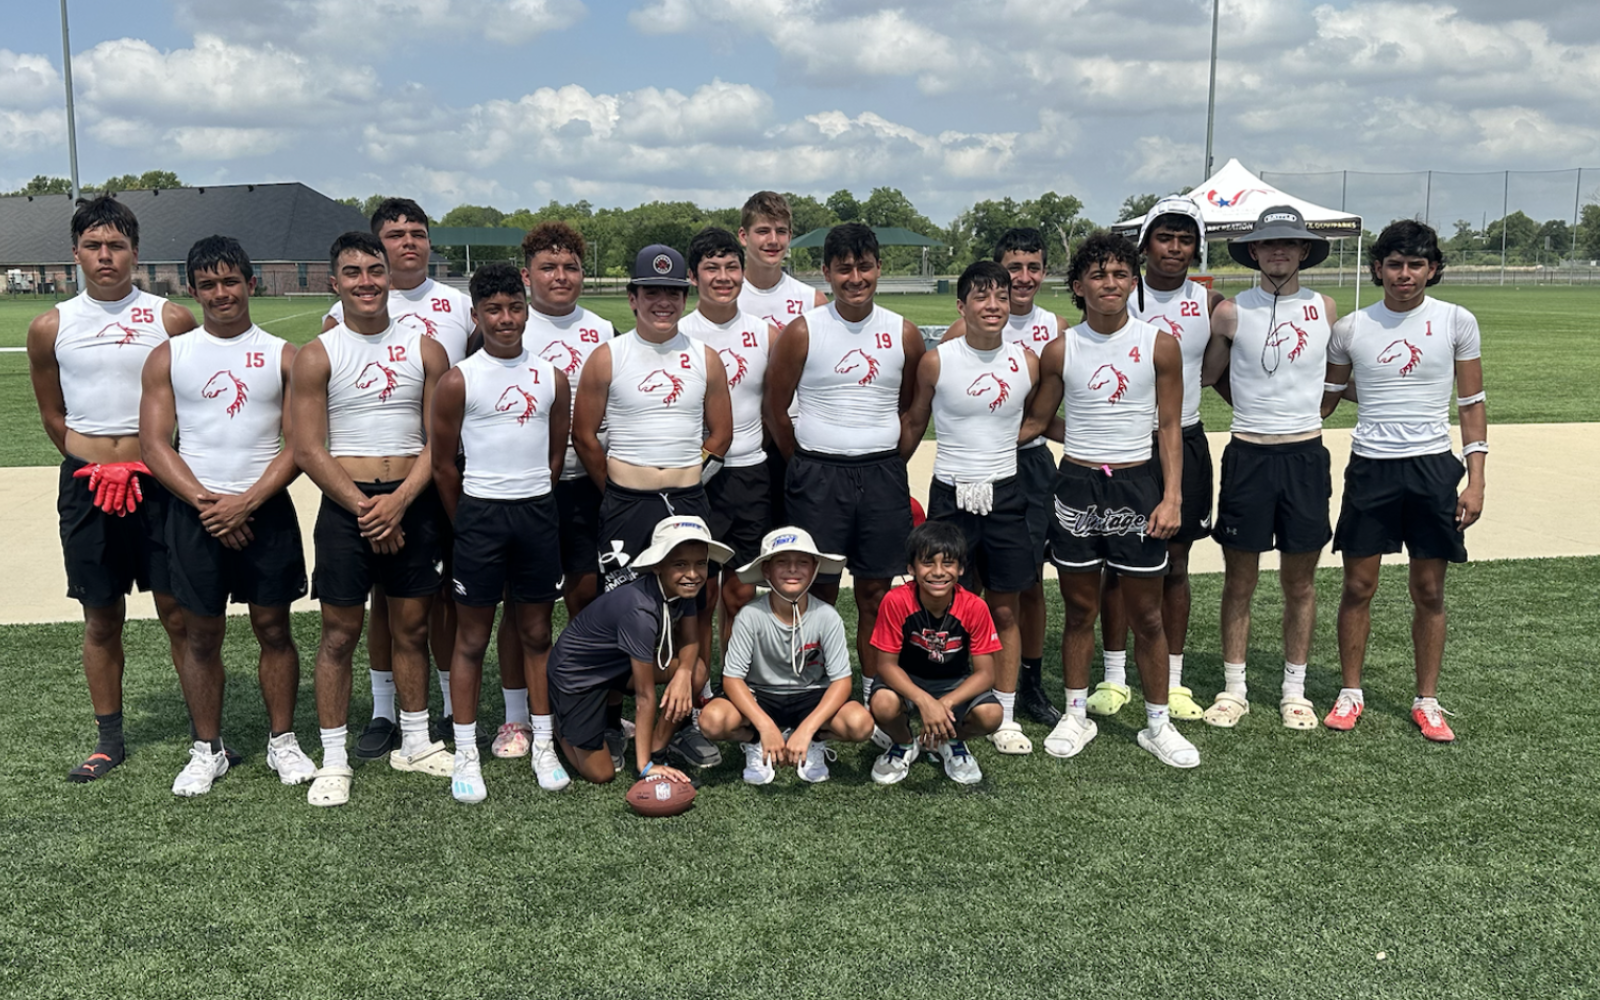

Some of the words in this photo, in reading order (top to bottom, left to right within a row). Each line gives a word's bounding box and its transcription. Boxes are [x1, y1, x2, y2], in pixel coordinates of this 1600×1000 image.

[431, 297, 451, 313] 28
[786, 299, 803, 315] 27
[1180, 300, 1200, 317] 22
[1303, 304, 1318, 321] 10
[130, 307, 155, 324] 25
[579, 327, 600, 343] 29
[1032, 325, 1050, 342] 23
[1424, 320, 1433, 337] 1
[742, 331, 759, 348] 21
[875, 332, 892, 349] 19
[245, 352, 265, 368] 15
[387, 345, 407, 363] 12
[680, 353, 691, 369] 2
[1128, 346, 1141, 363] 4
[1008, 357, 1019, 373] 3
[529, 368, 541, 384] 7
